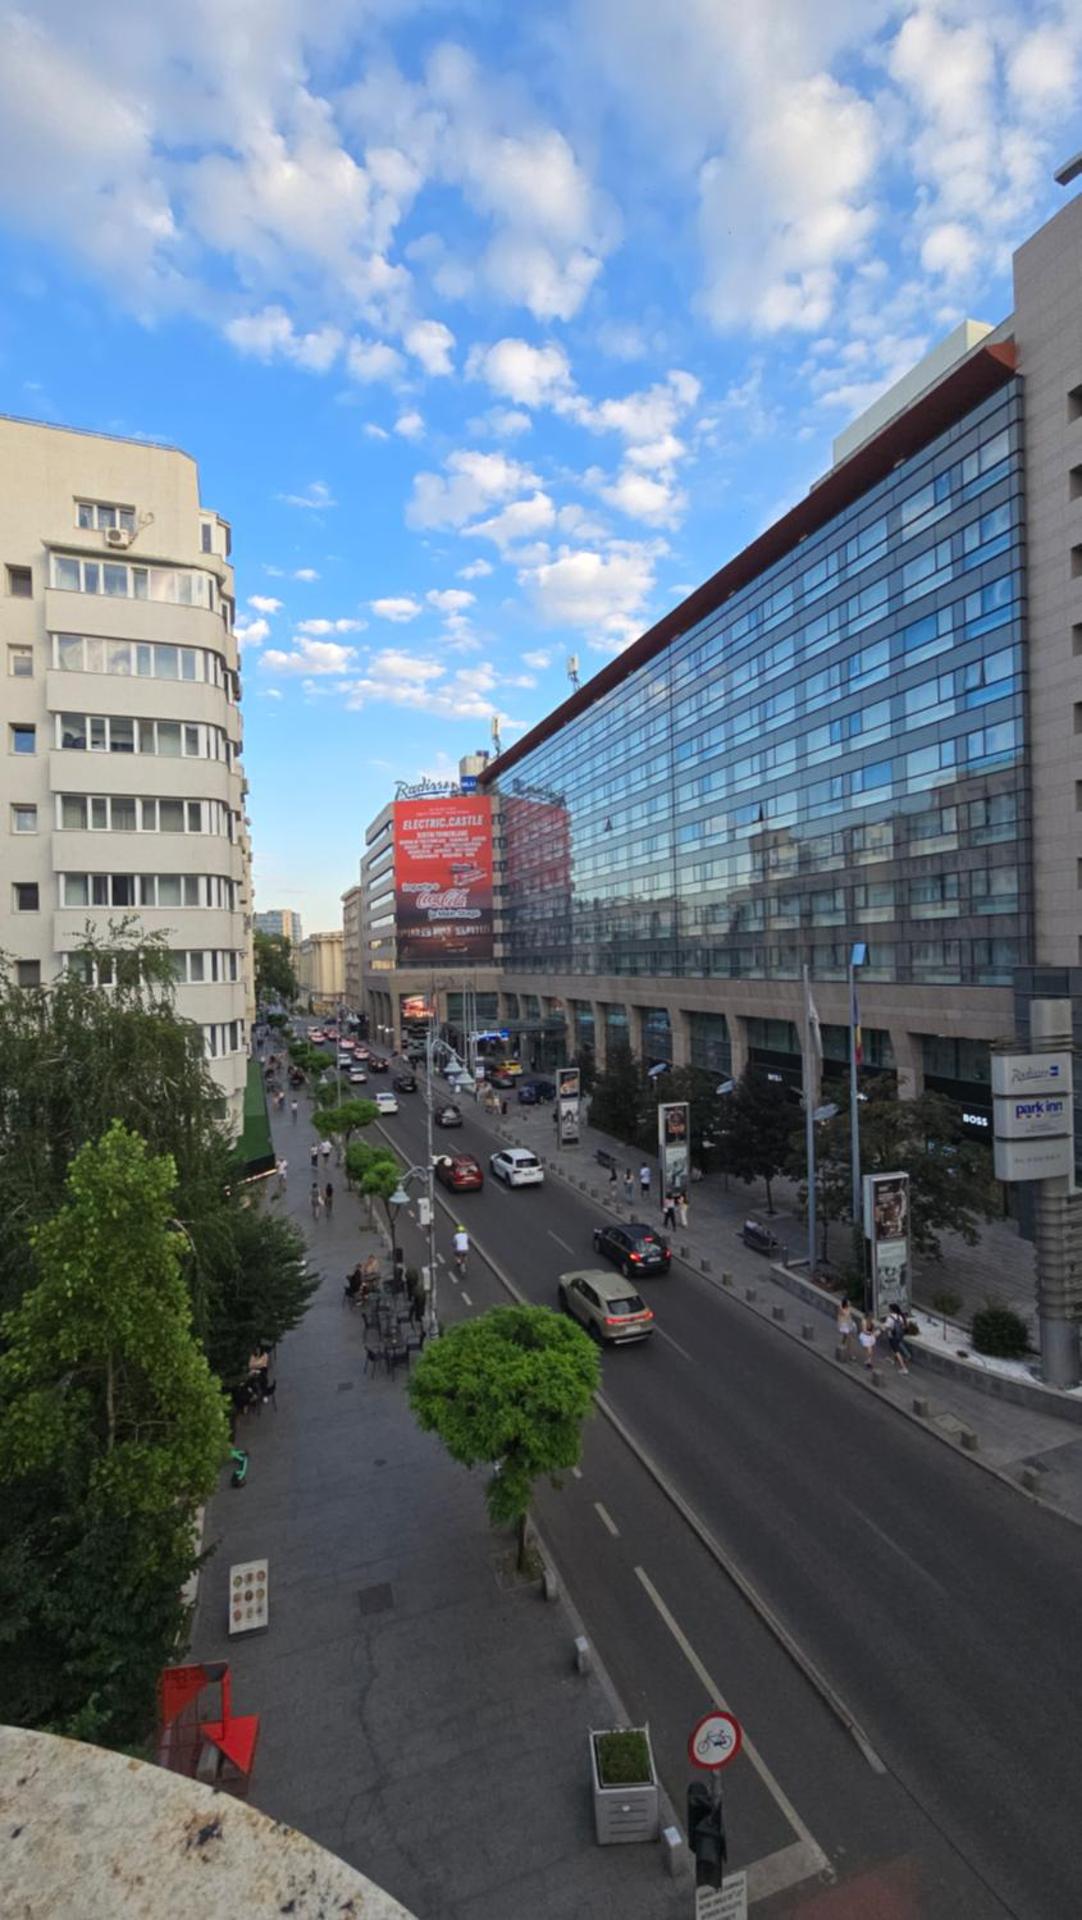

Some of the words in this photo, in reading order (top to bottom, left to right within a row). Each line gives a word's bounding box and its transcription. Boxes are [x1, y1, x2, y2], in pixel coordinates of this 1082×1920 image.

[394, 777, 460, 800] Radisson
[1016, 1101, 1044, 1119] park
[1046, 1100, 1063, 1112] inn
[963, 1114, 988, 1127] BOSS
